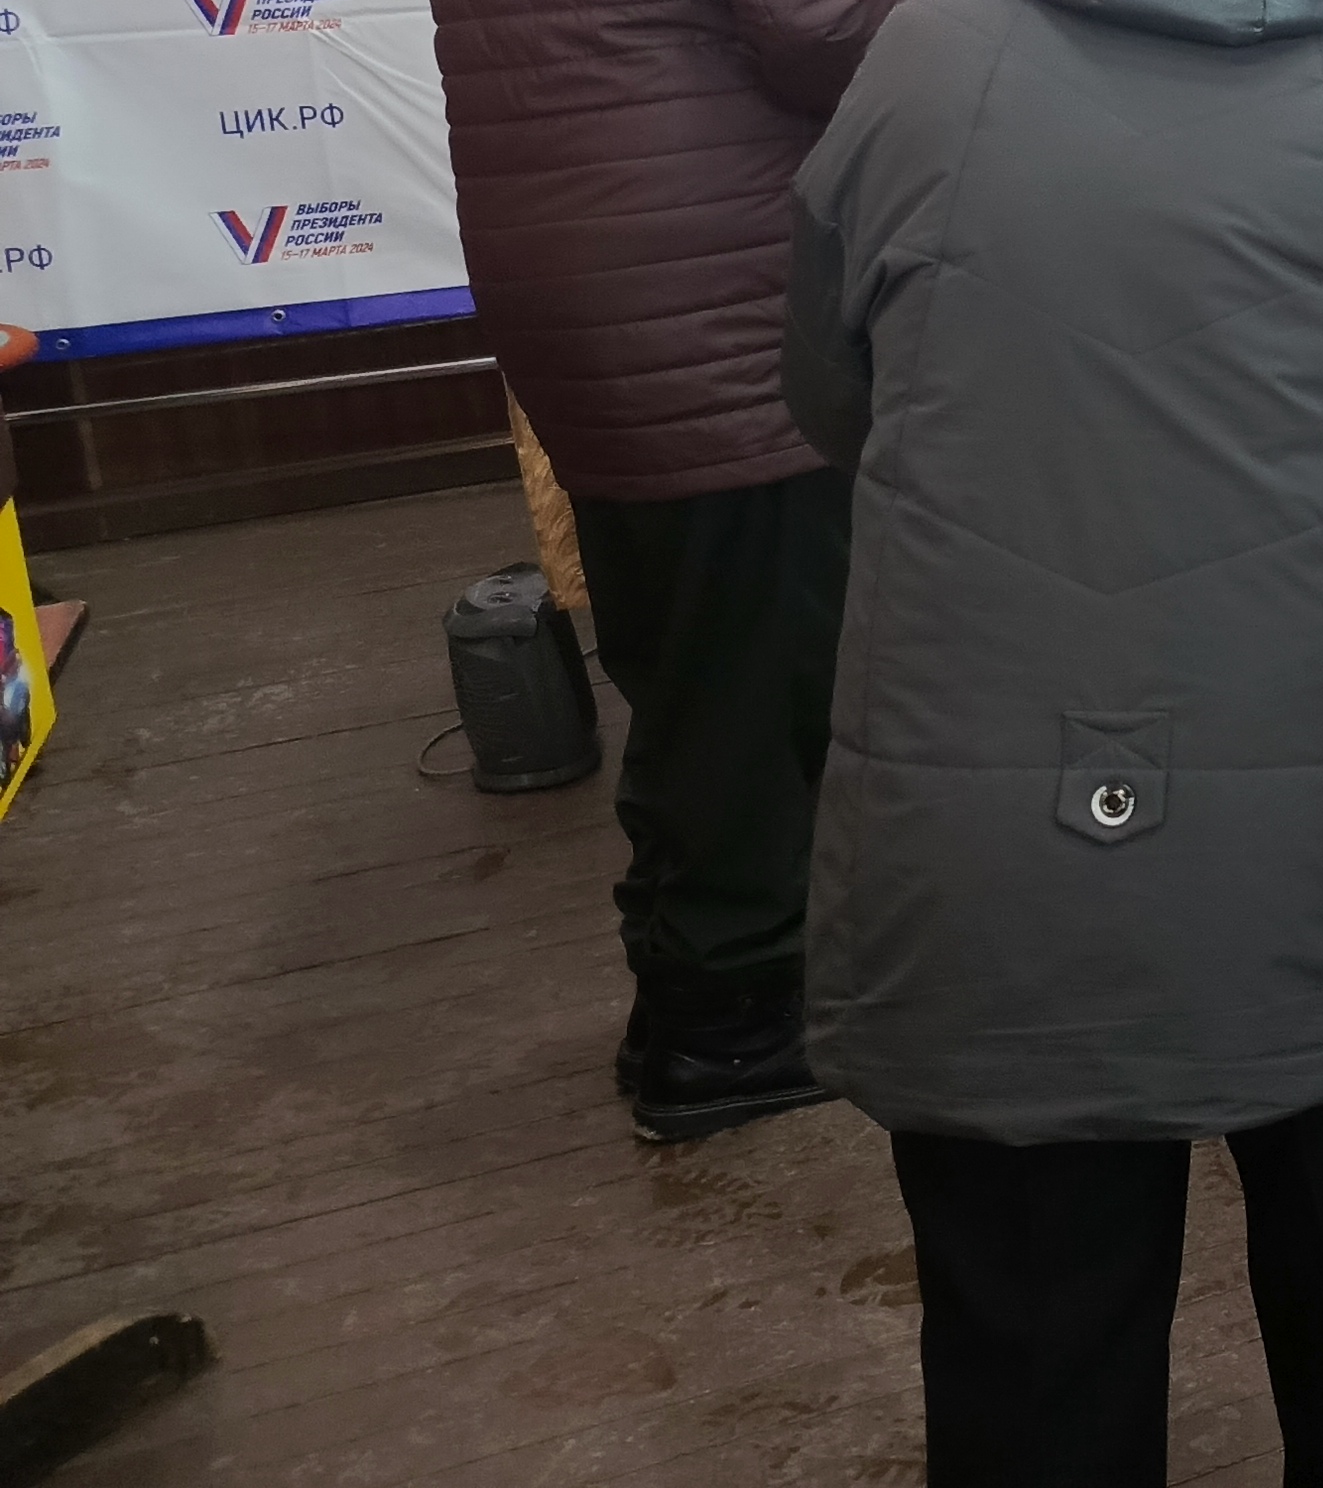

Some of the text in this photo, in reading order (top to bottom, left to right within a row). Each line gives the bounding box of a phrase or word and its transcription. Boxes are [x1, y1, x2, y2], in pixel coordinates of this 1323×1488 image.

[251, 5, 313, 21] РОССИИ
[0, 112, 38, 126] ОРЫ
[219, 102, 345, 139] ЦИК.РФ
[0, 126, 61, 143] ИДЕНТА
[296, 199, 362, 216] ВЫБОРЫ
[290, 213, 384, 232] ПРЕЗИДЕНТА
[285, 230, 346, 247] РОССИИ
[0, 244, 53, 273] .РФ
[312, 245, 348, 258] МАРТА
